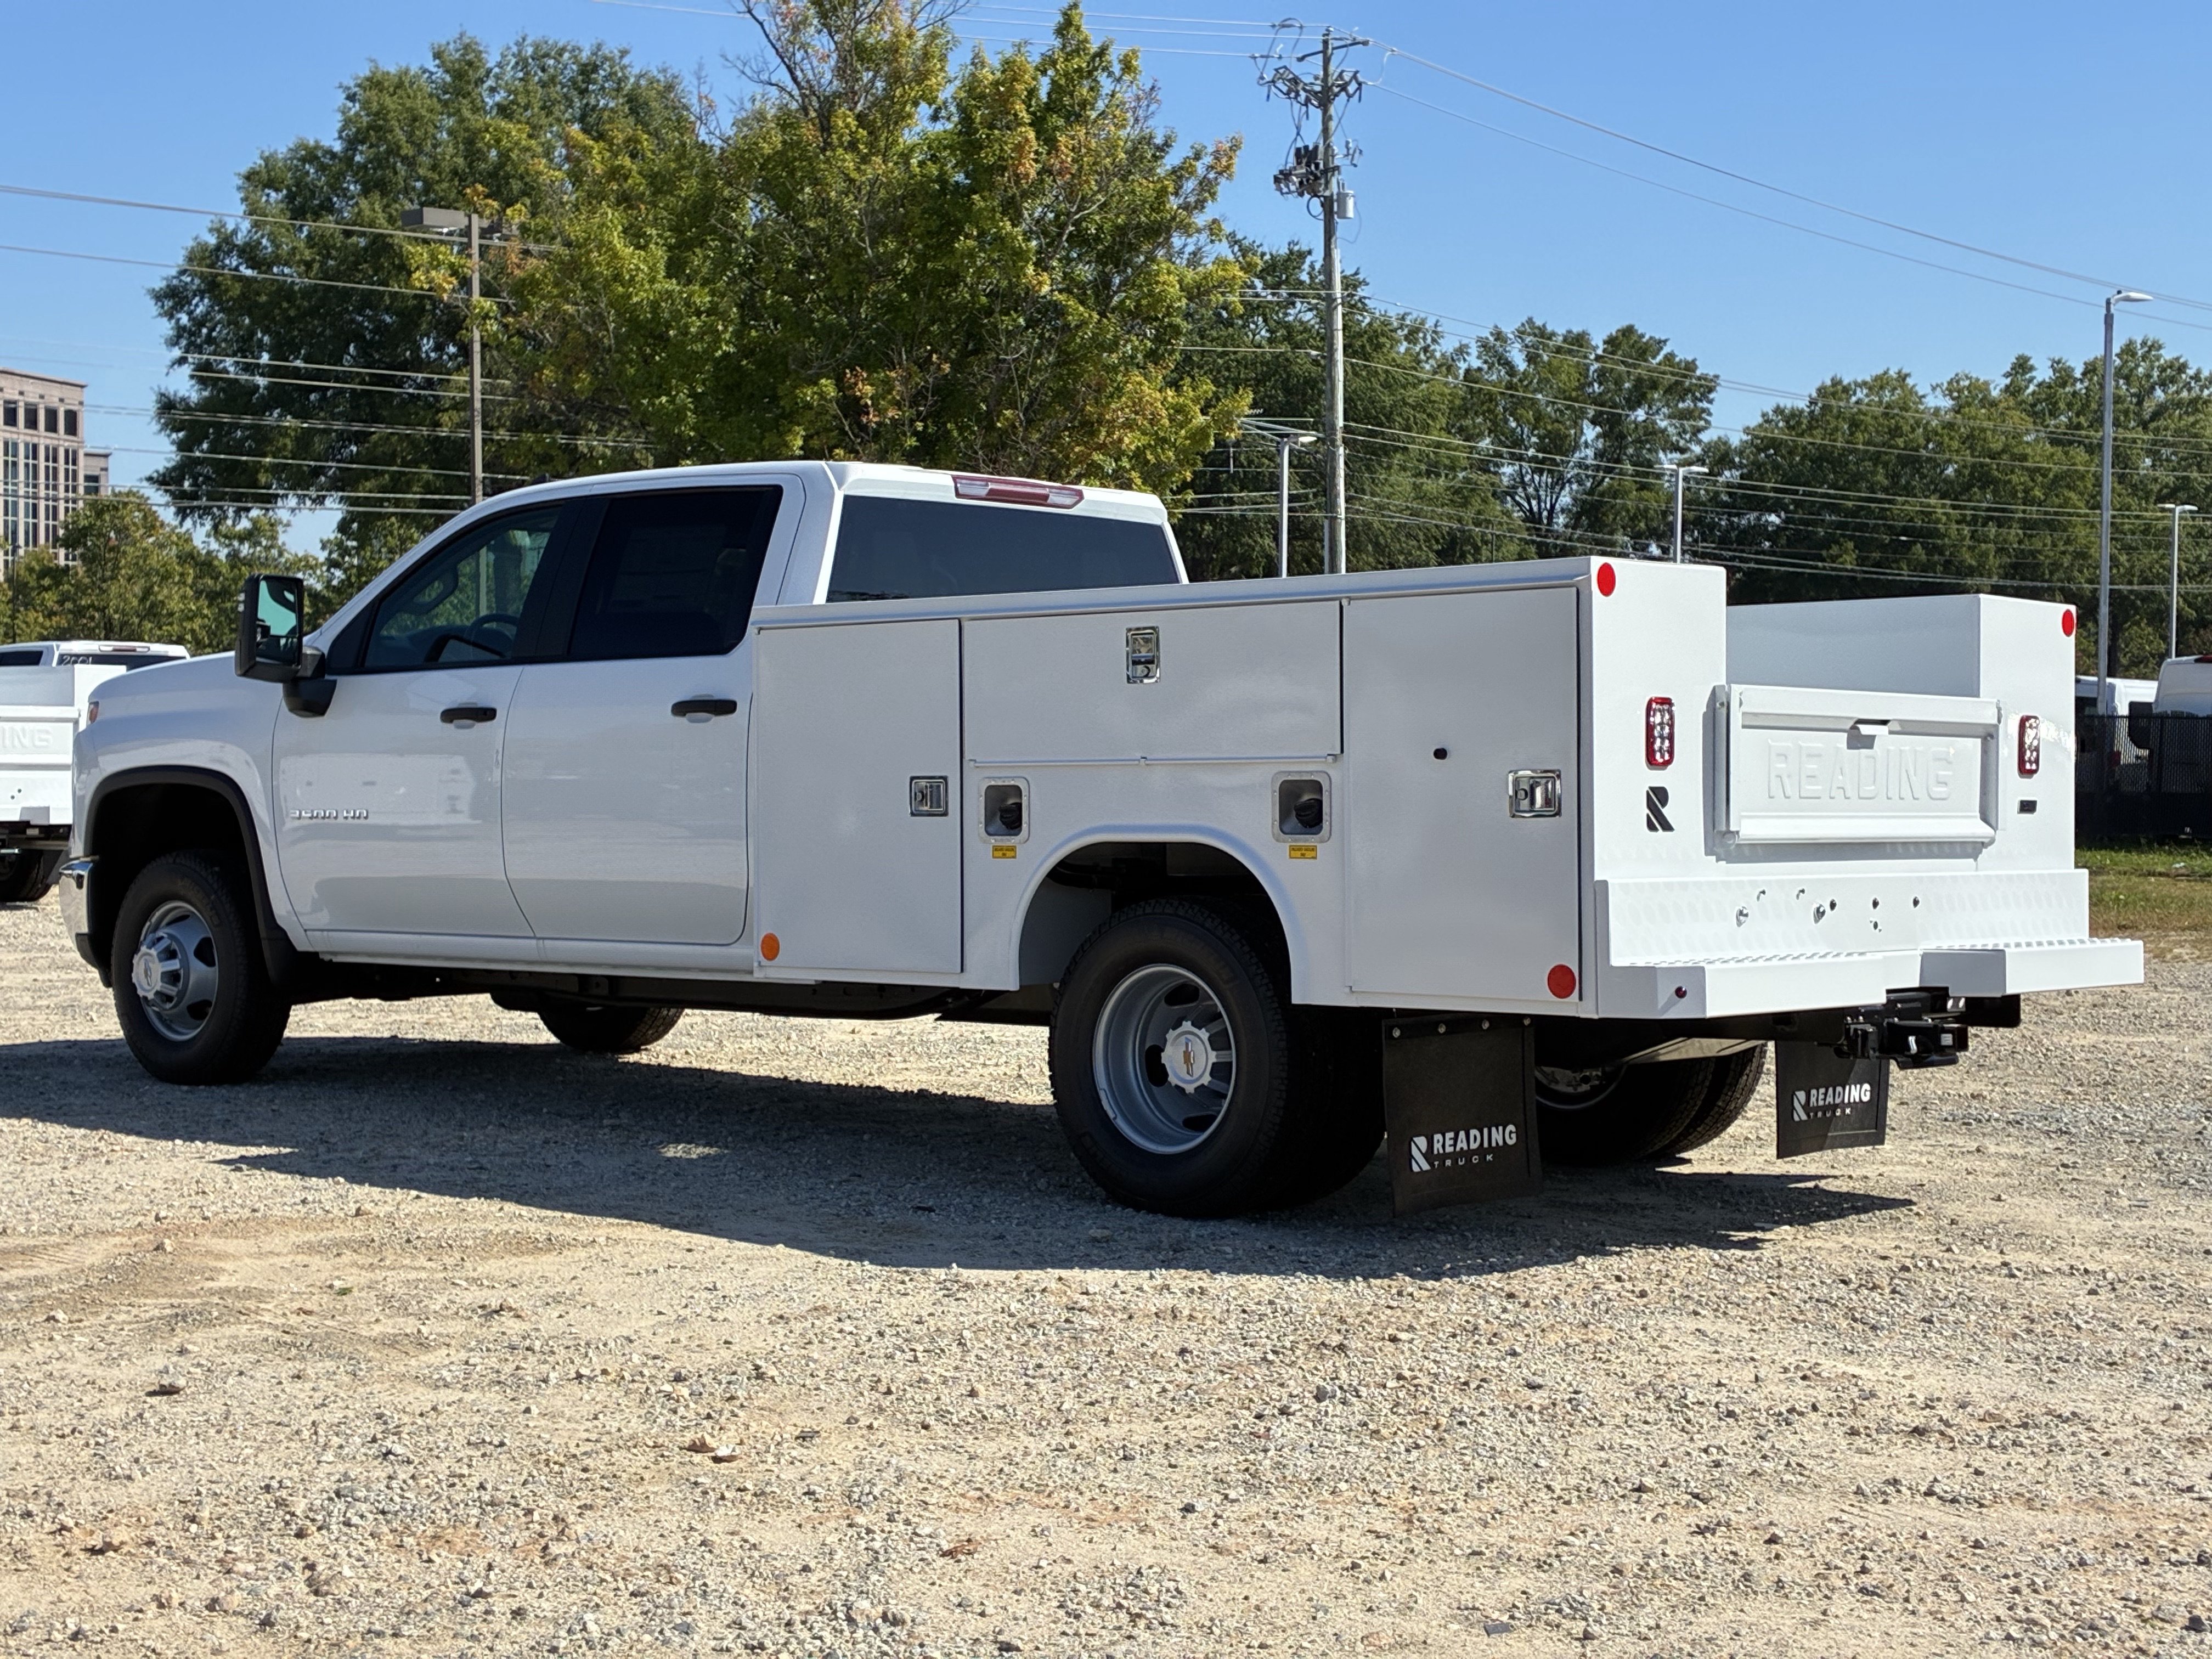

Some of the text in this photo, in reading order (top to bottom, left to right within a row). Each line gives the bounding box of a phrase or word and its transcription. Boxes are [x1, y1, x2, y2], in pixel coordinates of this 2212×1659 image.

[1768, 740, 1955, 800] READING
[1810, 1083, 1871, 1107] READING
[1810, 1108, 1852, 1119] TRUCK
[1434, 1125, 1517, 1154] READING
[1434, 1154, 1493, 1169] TRUCK
